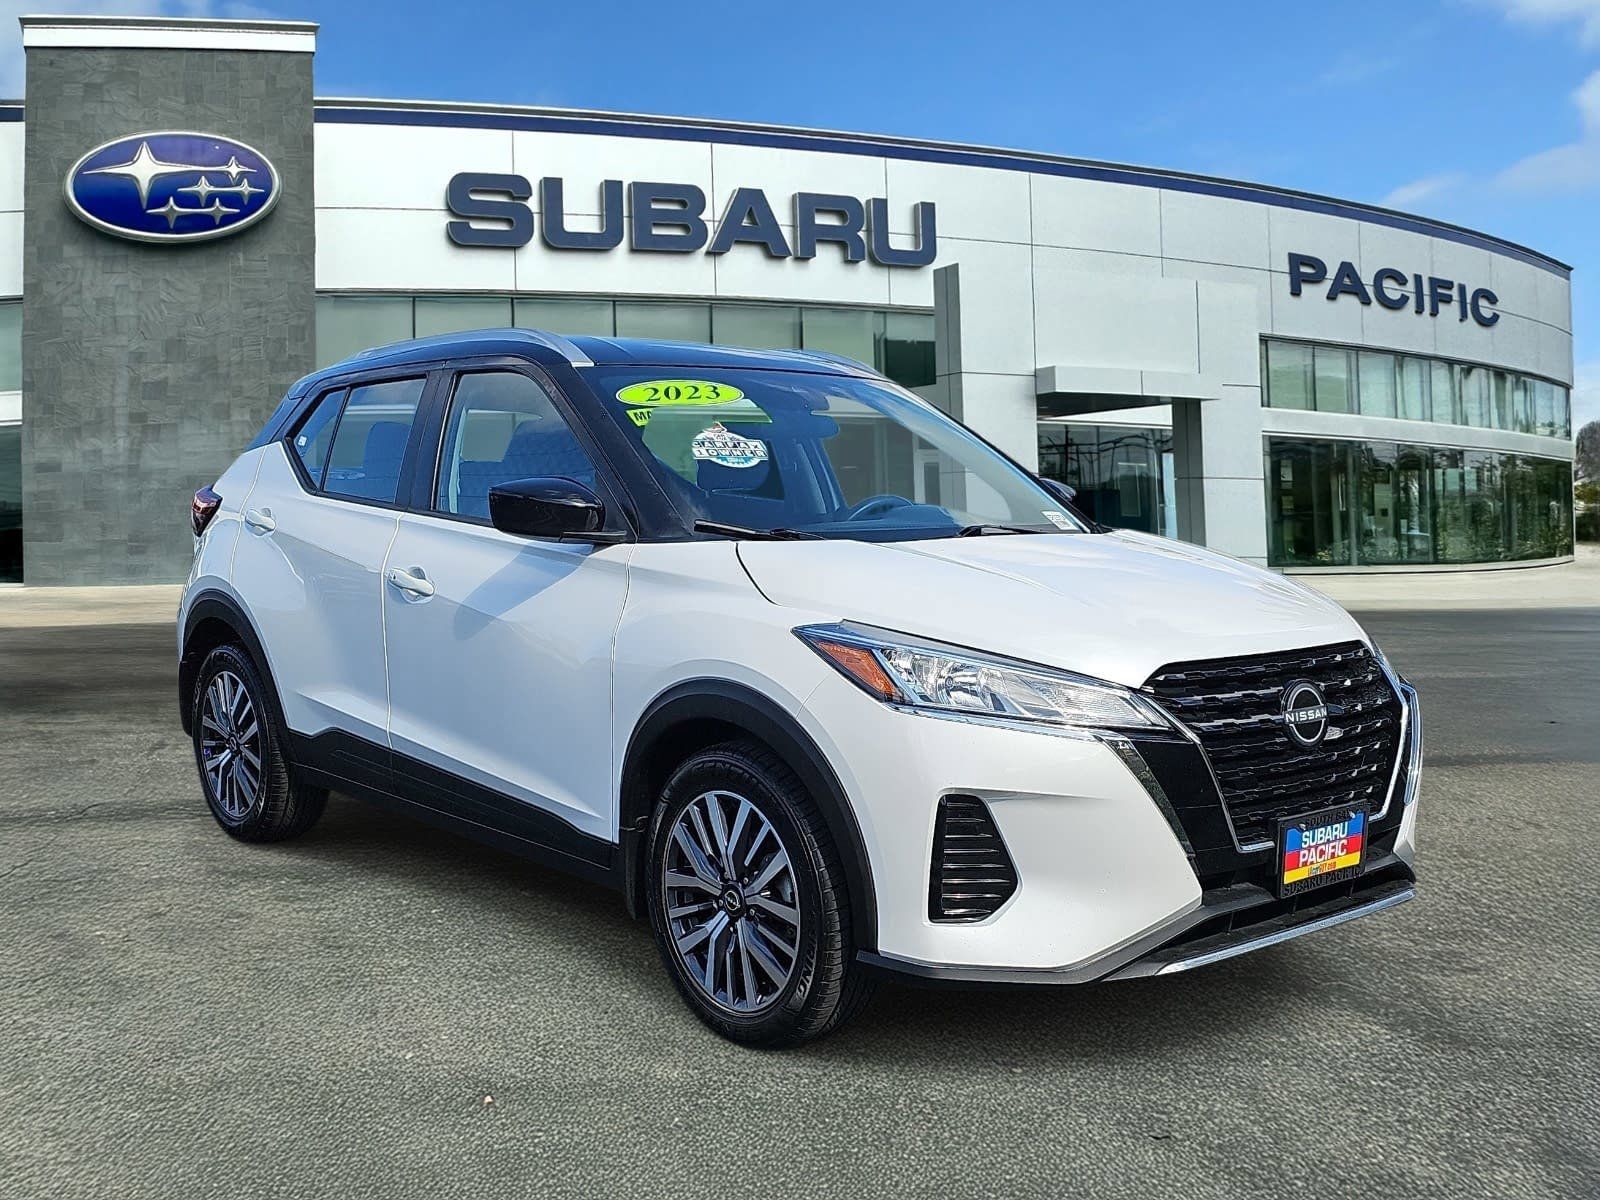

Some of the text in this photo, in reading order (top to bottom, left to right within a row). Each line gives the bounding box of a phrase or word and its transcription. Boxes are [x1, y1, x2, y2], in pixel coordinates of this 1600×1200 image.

[446, 171, 937, 268] SUBARU
[1288, 252, 1500, 327] PACIFIC
[643, 385, 720, 402] 2023
[692, 440, 760, 449] CARFAX
[707, 449, 767, 457] OWNER
[1285, 707, 1327, 722] NISSAN
[1301, 821, 1348, 848] SUBARU
[1298, 839, 1348, 867] PACIFIC
[1283, 875, 1322, 896] SUBARU
